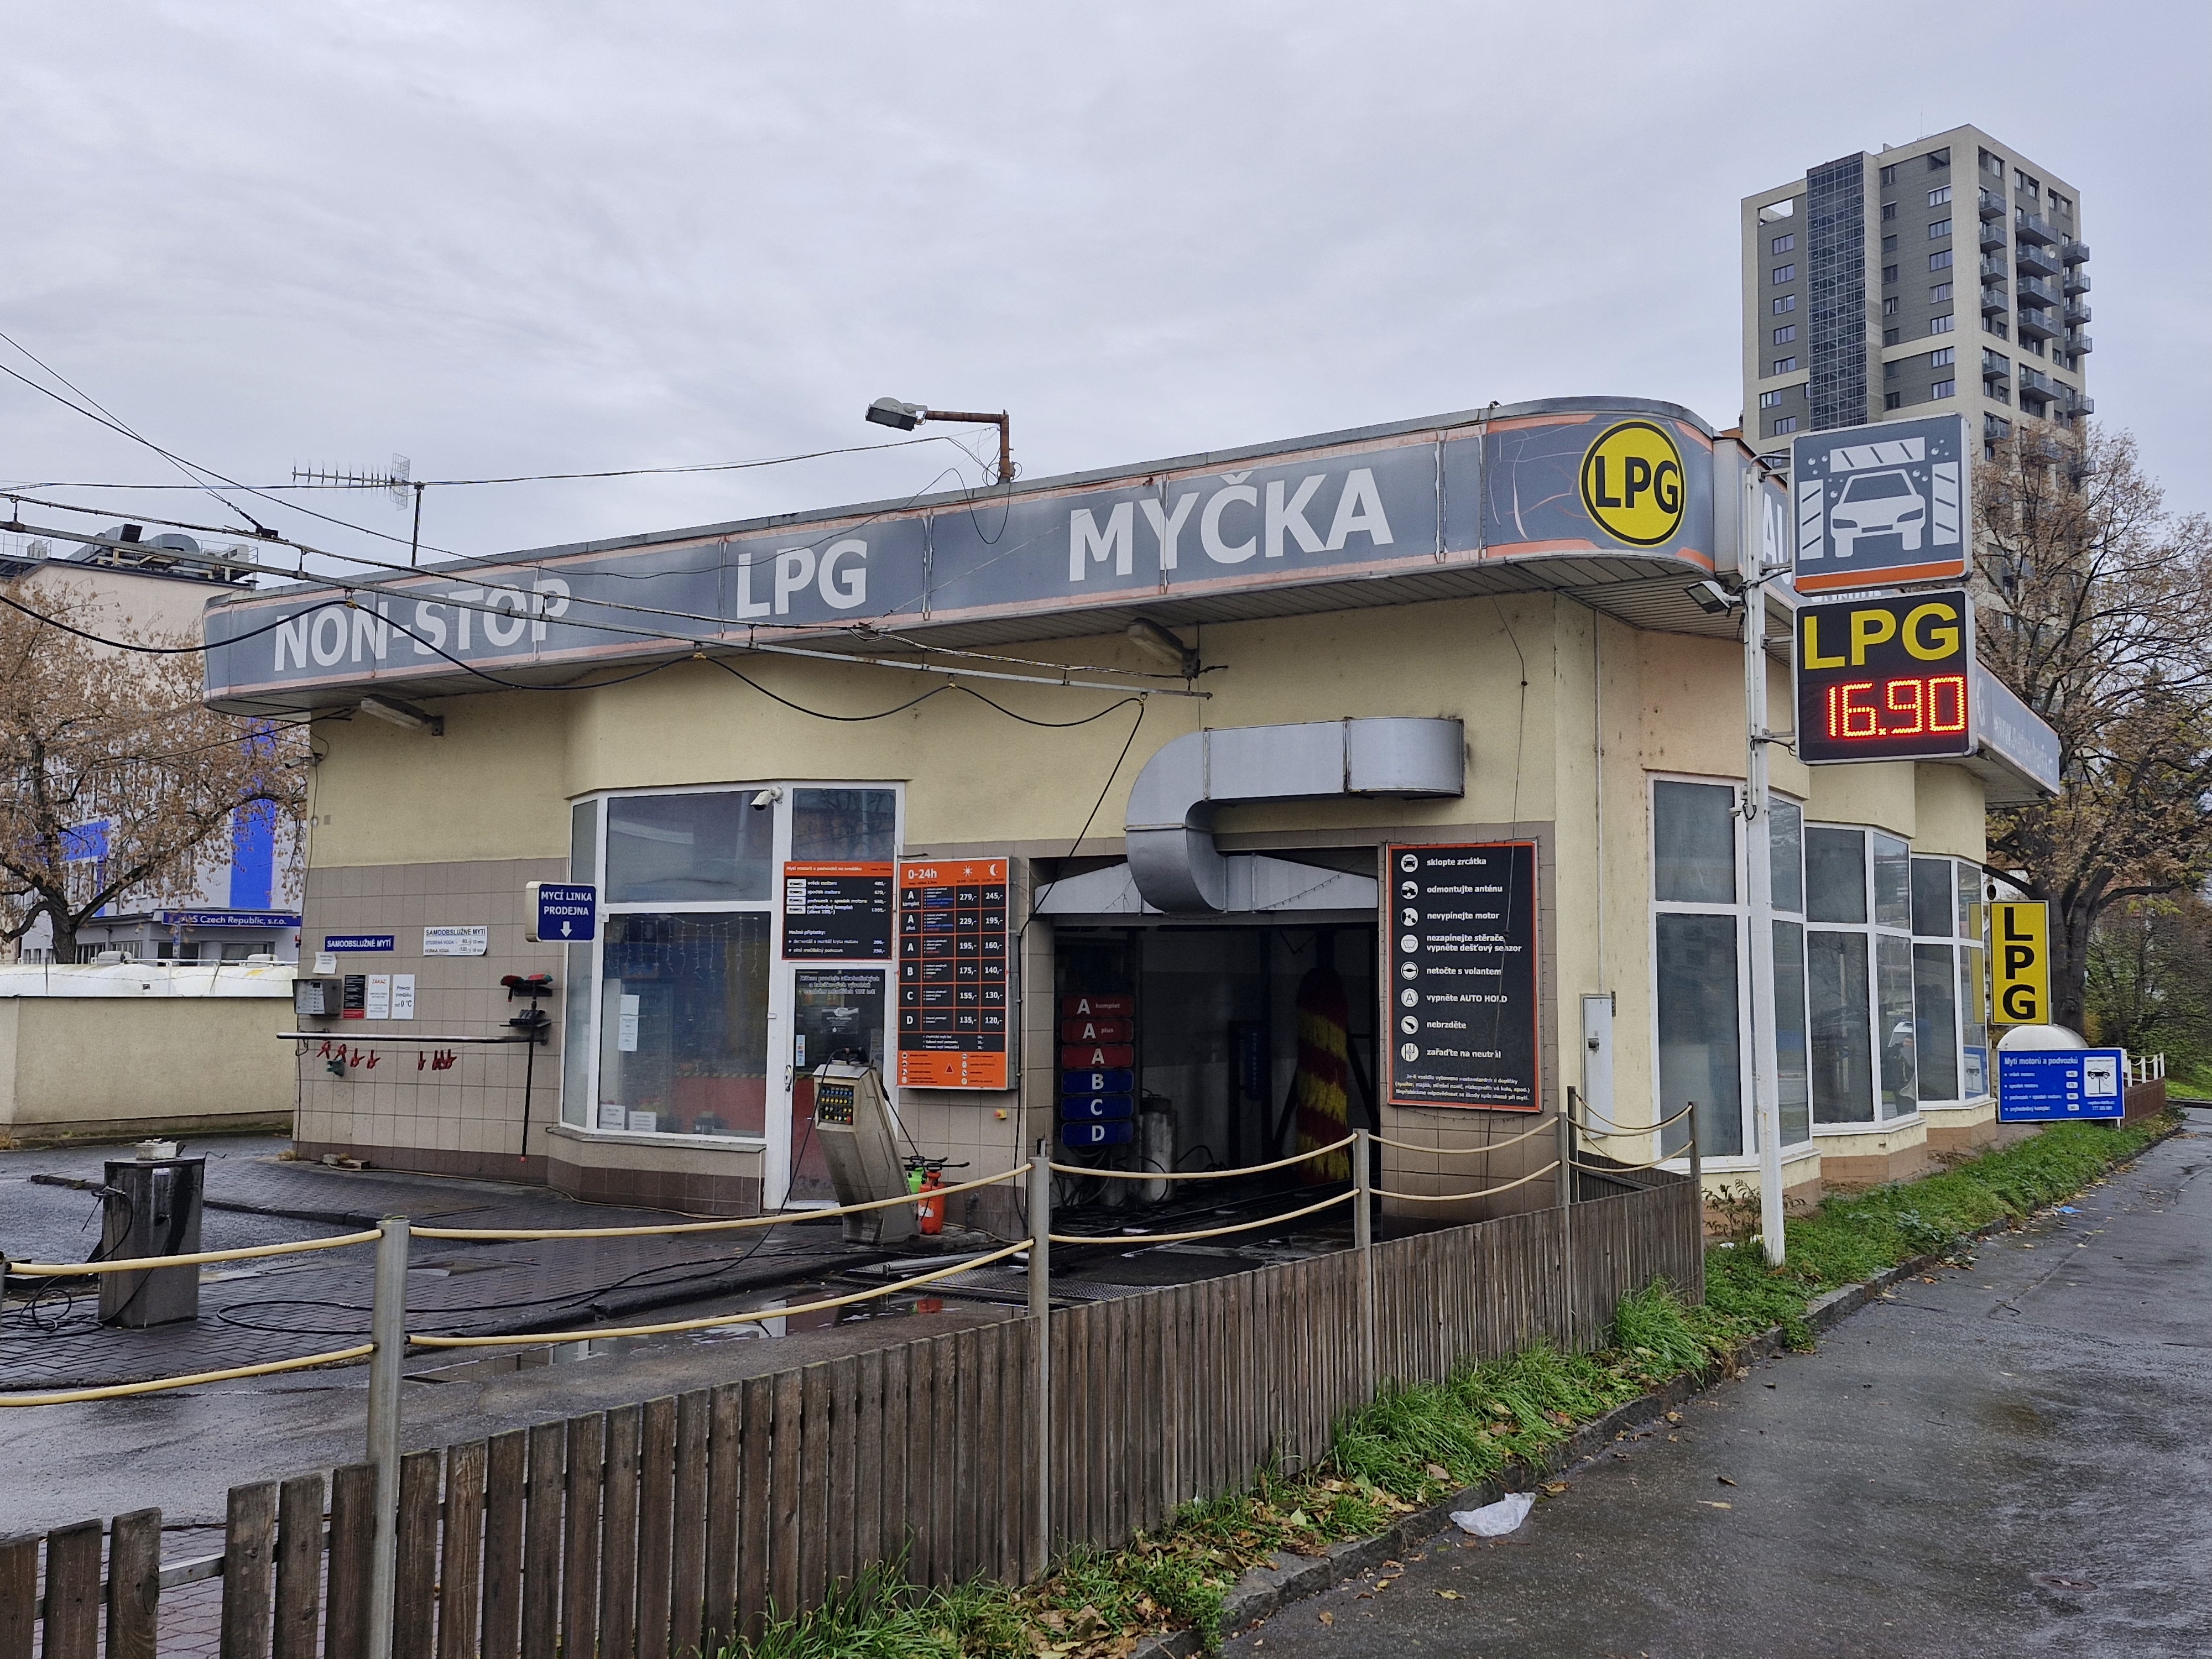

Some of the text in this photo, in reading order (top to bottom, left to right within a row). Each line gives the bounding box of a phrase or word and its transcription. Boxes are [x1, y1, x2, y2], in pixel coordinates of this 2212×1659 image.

[1595, 456, 1678, 514] LPG
[1069, 468, 1394, 581] MYČKA
[737, 539, 867, 619] LPG
[274, 578, 570, 671] NON-STOP
[1804, 603, 1959, 670] LPG
[1828, 675, 1965, 738] 16.90
[1427, 857, 1486, 867] sklopte zrcátka
[908, 868, 937, 879] 0-24h
[1427, 884, 1503, 894] odmontujte anténu
[541, 889, 592, 901] MYCÍ LINKA
[907, 891, 914, 899] A
[959, 893, 977, 901] 279,-
[985, 892, 1003, 900] 245,-
[544, 906, 589, 916] PRODEJNA
[227, 916, 266, 925] Republic,
[907, 915, 914, 924] A
[985, 917, 1003, 925] 195,-
[1427, 912, 1473, 921] nevypínejte
[426, 927, 471, 936] SAMOOBSLUŽNÉ
[327, 938, 392, 948] SAMOOBSLUŽNÉ MYTÍ
[1427, 933, 1505, 943] nezapínejte stěrače,
[907, 943, 914, 952] A
[985, 942, 1003, 950] 160,-
[1427, 945, 1458, 953] vypněte
[1459, 943, 1493, 953] dešťový
[2002, 906, 2036, 1020] LPG
[907, 967, 914, 976] B
[959, 967, 977, 975] 175,-
[985, 966, 1003, 975] 140,-
[1427, 967, 1456, 975] netočte
[907, 991, 1003, 1000] C 155,- 130,-
[1427, 994, 1507, 1003] vypněte AUTO HOLD
[1077, 999, 1091, 1014] A
[906, 1016, 913, 1025] D
[959, 1016, 977, 1025] 135,-
[985, 1017, 1003, 1025] 120,-
[1427, 1020, 1467, 1029] nebrzděte
[1082, 1023, 1096, 1039] A
[1091, 1048, 1105, 1065] A
[1427, 1048, 1458, 1057] zařaďte
[1472, 1050, 1501, 1058] neutrál
[2004, 1057, 2018, 1067] Mytí
[2019, 1056, 2041, 1065] motorů
[1092, 1074, 1104, 1090] B
[1091, 1099, 1103, 1115] C
[1092, 1125, 1105, 1141] D
